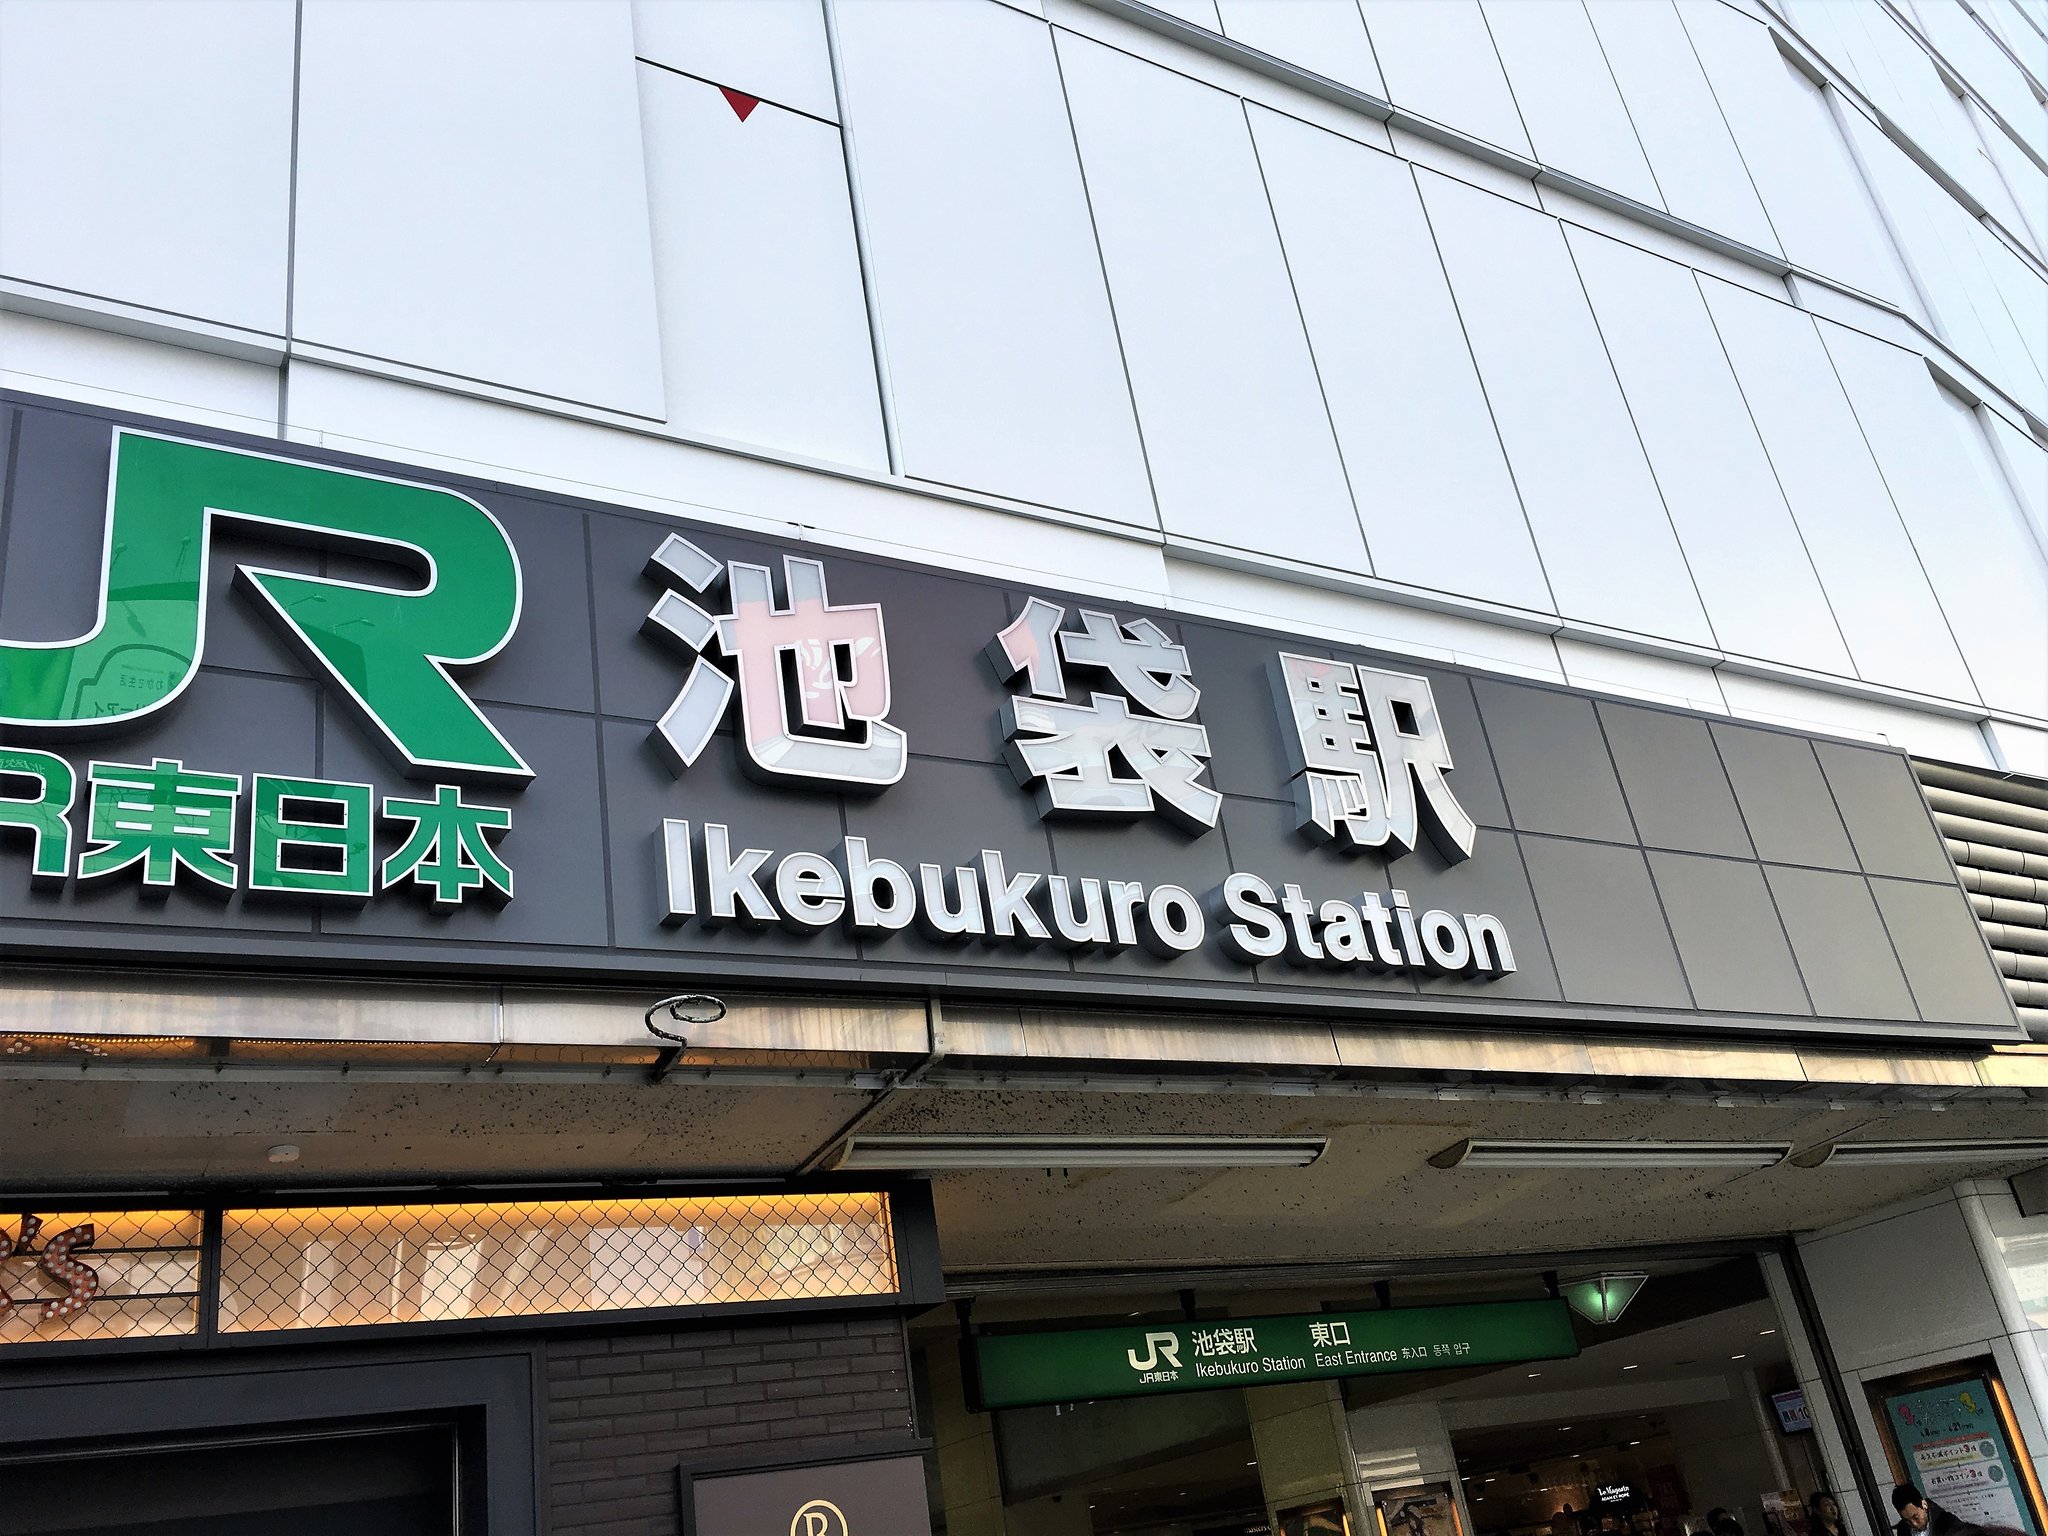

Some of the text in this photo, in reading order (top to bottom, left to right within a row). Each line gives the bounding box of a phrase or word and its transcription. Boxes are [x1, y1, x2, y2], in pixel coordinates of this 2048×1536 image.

[0, 426, 537, 778] JR
[644, 532, 1477, 861] 池袋駅
[662, 817, 1518, 975] Ikebukuro Station
[1127, 1331, 1184, 1371] JR
[1191, 1321, 1352, 1358] 池袋駅 東口
[1139, 1370, 1179, 1384] JR東日本
[1195, 1358, 1259, 1378] Ikebukuro
[1262, 1355, 1306, 1373] Station
[1314, 1351, 1344, 1368] East
[1345, 1347, 1398, 1365] Entrance
